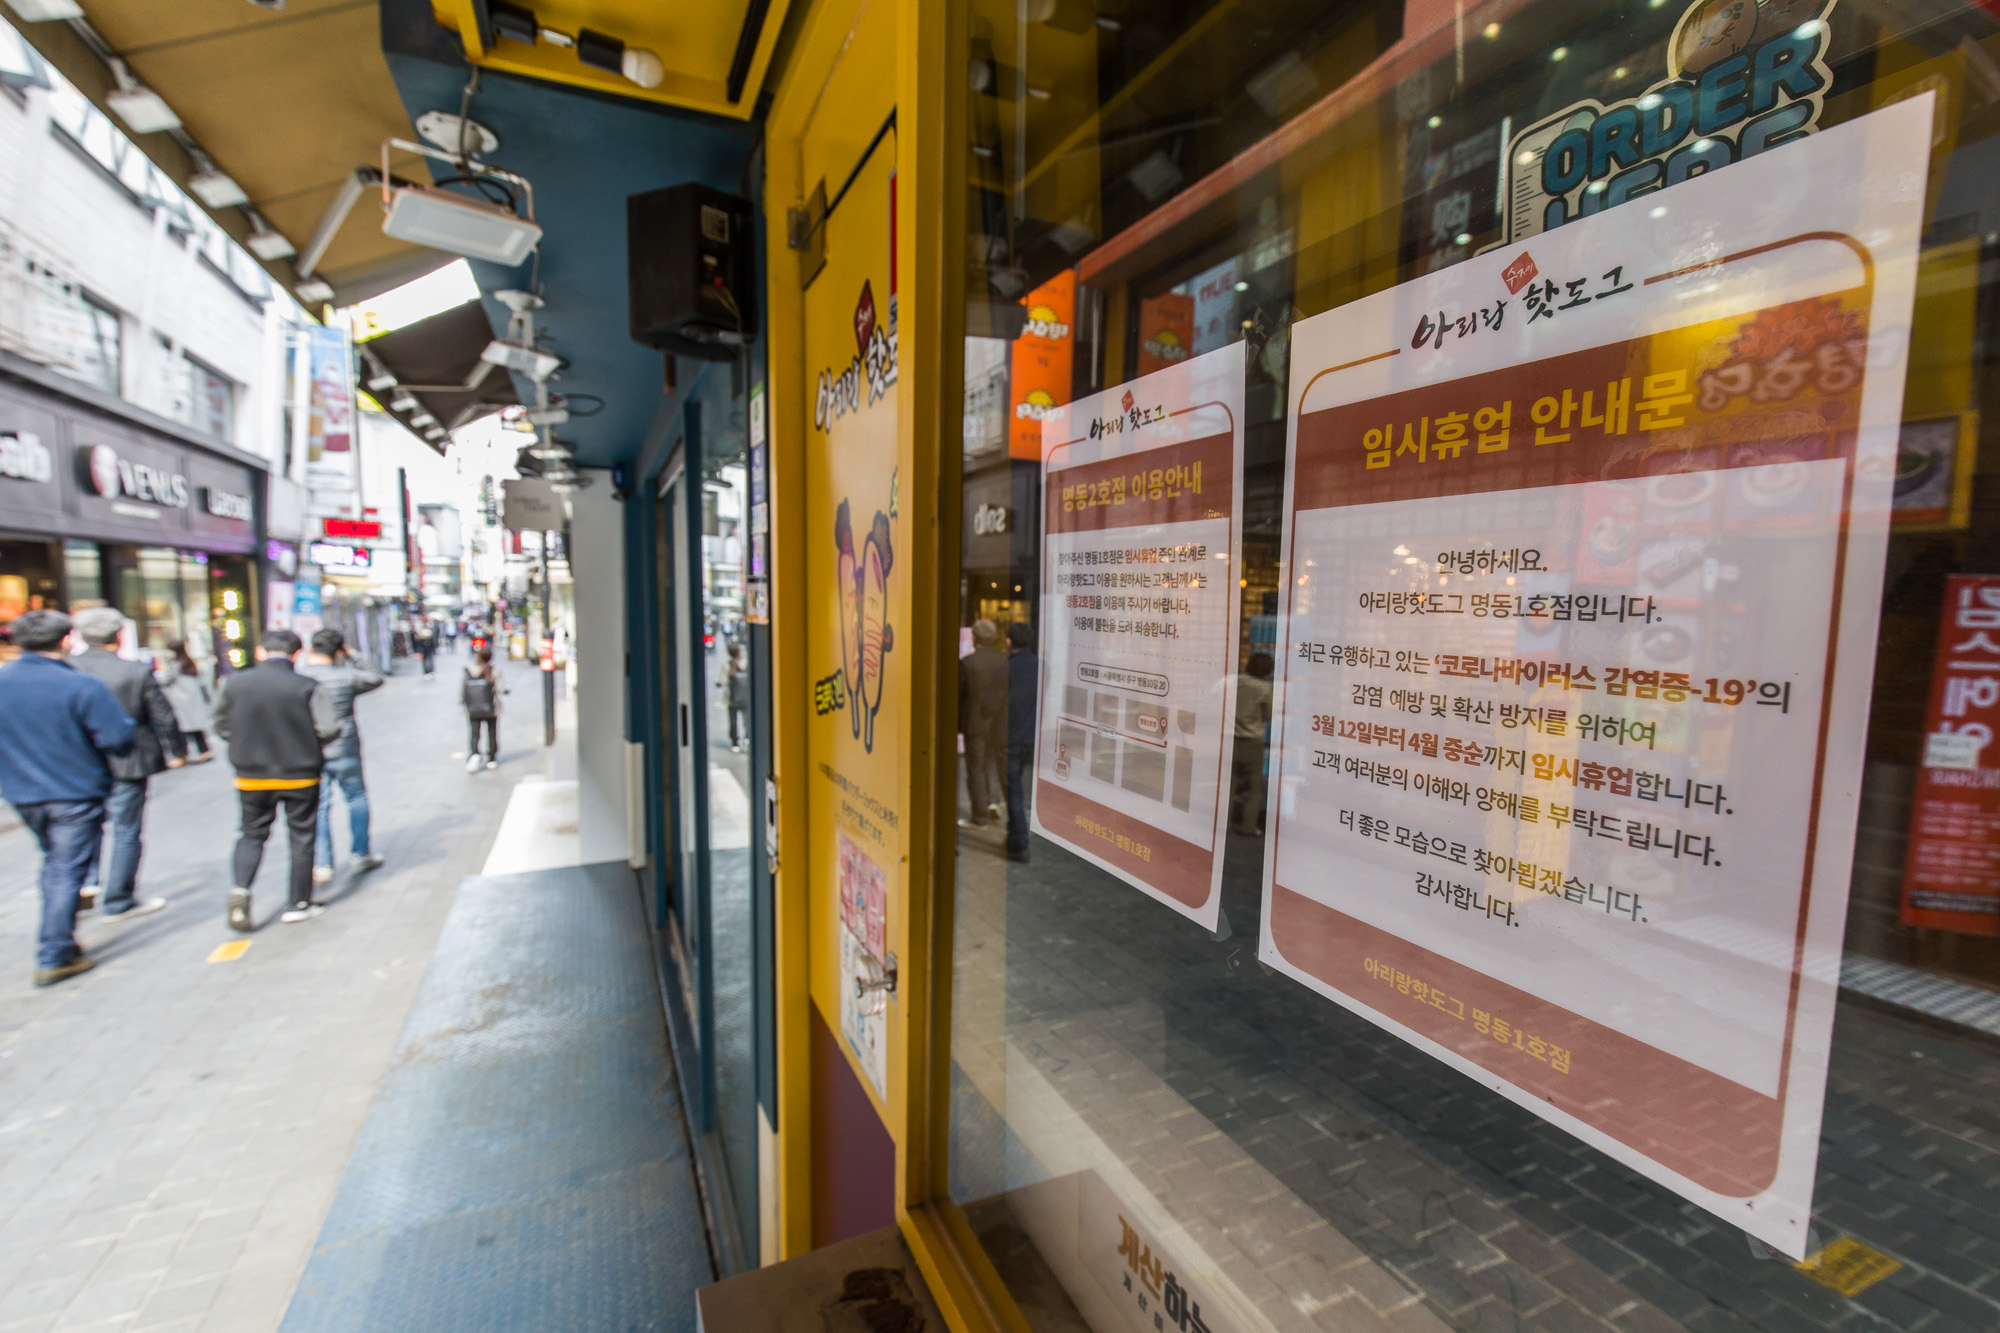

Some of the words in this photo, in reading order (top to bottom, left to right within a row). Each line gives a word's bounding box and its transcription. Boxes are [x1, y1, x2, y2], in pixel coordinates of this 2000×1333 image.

[1543, 28, 1822, 196] ORDER
[1411, 300, 1508, 350] 아리랑
[1522, 265, 1634, 325] 핫도그
[1089, 414, 1124, 440] 아리랑
[1129, 404, 1166, 433] 핫도그
[1362, 400, 1512, 470] 임시휴업
[1530, 369, 1694, 446] 안내문
[1062, 474, 1126, 513] 명동2호점
[1132, 460, 1202, 502] 이용안내
[1057, 573, 1095, 587] 아리랑핫도그
[1097, 572, 1118, 588] 이용을
[1120, 572, 1151, 588] 원하시는
[1153, 571, 1207, 589] 고객님께서는
[1085, 549, 1124, 565] 명동1호점은
[1125, 547, 1157, 564] 임시휴업
[1178, 545, 1207, 563] 관계로
[1437, 548, 1548, 575] 안녕하세요.
[1066, 594, 1102, 610] 명동2호점을
[1104, 595, 1126, 611] 이용해
[1127, 596, 1151, 612] 주시기
[1153, 597, 1191, 615] 바랍니다.
[1074, 616, 1094, 631] 이용에
[1118, 620, 1133, 635] 드려
[1134, 621, 1179, 639] 죄송합니다.
[1359, 591, 1464, 616] 아리랑핫도그
[1470, 593, 1663, 624] 명동1호점입니다.
[1298, 641, 1326, 664] 최근
[1328, 644, 1391, 670] 유행하고
[1395, 650, 1431, 675] 있는
[1351, 684, 1383, 708] 감염
[1389, 688, 1425, 714] 예방
[1429, 694, 1448, 718] 및
[1452, 696, 1494, 725] 확산
[1499, 703, 1569, 737] 방지를
[1575, 713, 1657, 750] 위하여
[1311, 714, 1336, 737] 3월
[1337, 719, 1406, 751] 12일부터
[1408, 731, 1439, 758] 4월
[1443, 736, 1526, 775] 중순까지
[1531, 752, 1733, 815] 임시휴업합니다.
[1312, 750, 1341, 774] 고객
[1344, 756, 1409, 791] 여러분의
[1413, 773, 1471, 806] 이해와
[1475, 787, 1541, 824] 양해를
[1547, 802, 1722, 867] 부탁드립니다.
[1339, 809, 1354, 831] 더
[1358, 813, 1390, 842] 좋은
[1394, 825, 1468, 866] 모습으로
[1473, 848, 1648, 923] 찾아뵙겠습니다.
[1415, 871, 1519, 928] 감사합니다.
[1363, 957, 1465, 1021] 아리랑핫도그
[1472, 1007, 1571, 1075] 명동1호점
